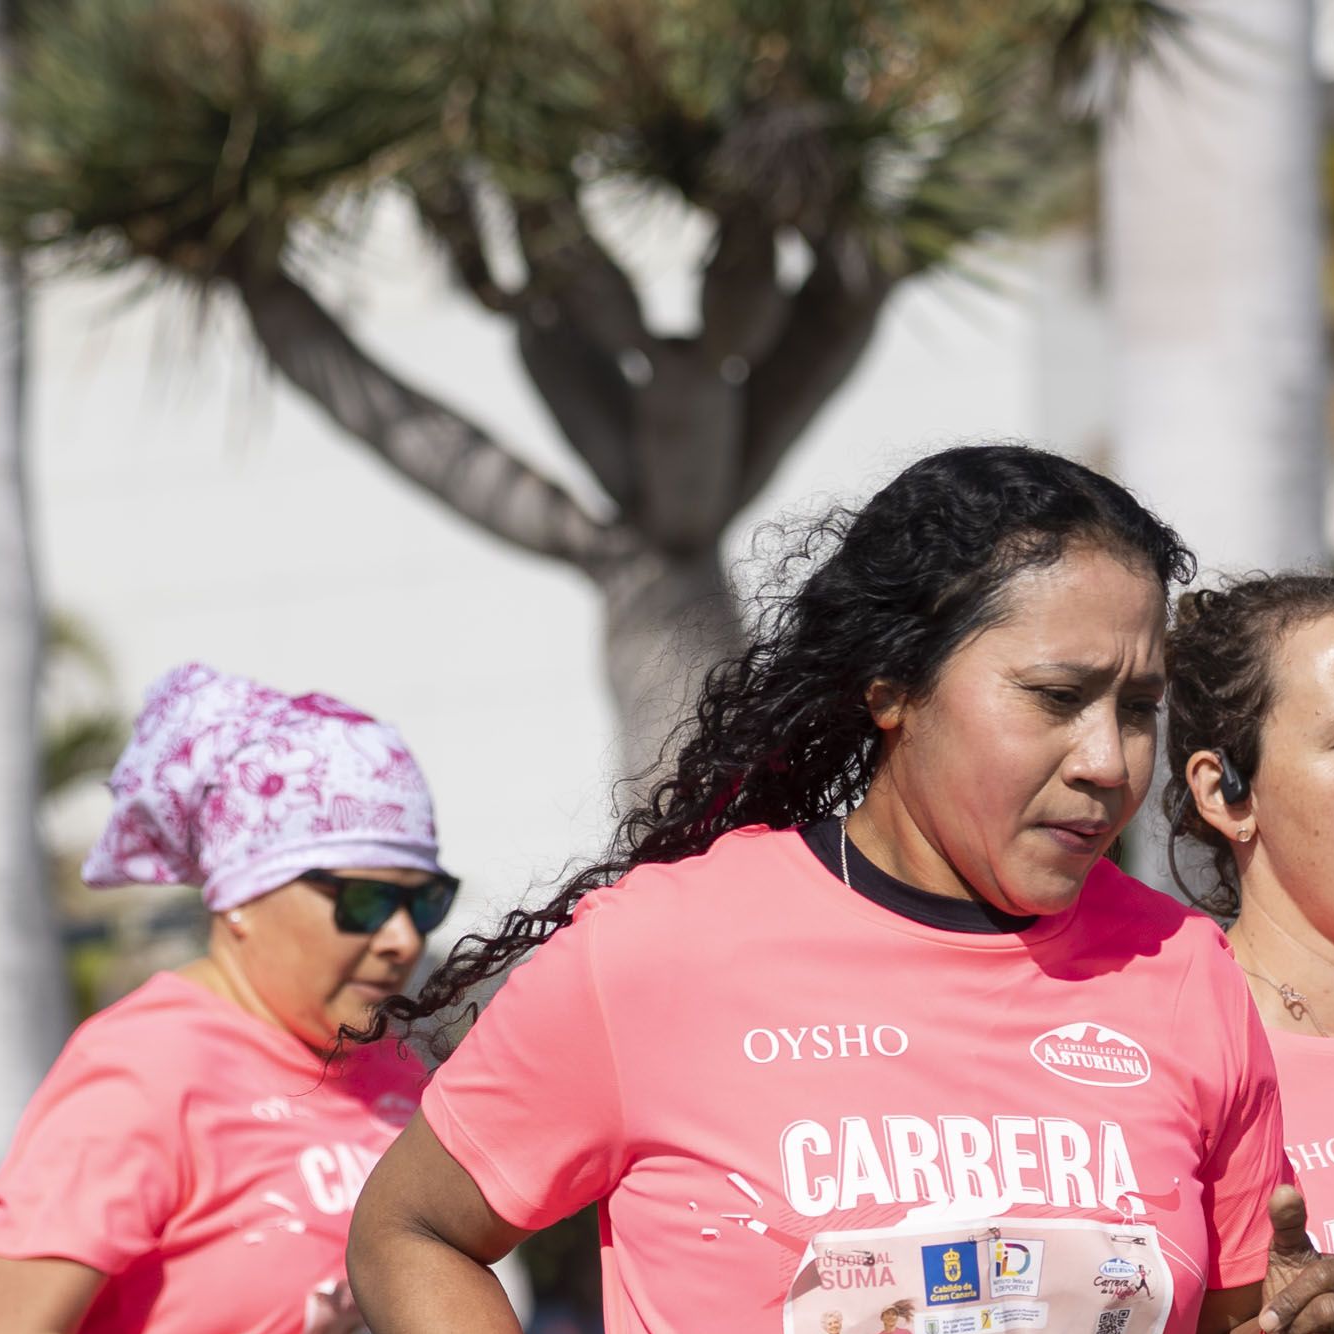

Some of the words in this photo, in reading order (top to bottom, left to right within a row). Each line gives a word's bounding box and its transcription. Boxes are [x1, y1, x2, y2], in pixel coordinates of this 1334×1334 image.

[743, 1024, 909, 1064] OYSHO
[1057, 1042, 1097, 1054] CENTRAL
[1099, 1046, 1139, 1058] LECHERA
[1044, 1043, 1146, 1077] ASTURIANA
[778, 1115, 1147, 1217] CARRERA
[836, 1251, 894, 1268] DORAL
[819, 1266, 897, 1291] SUMA
